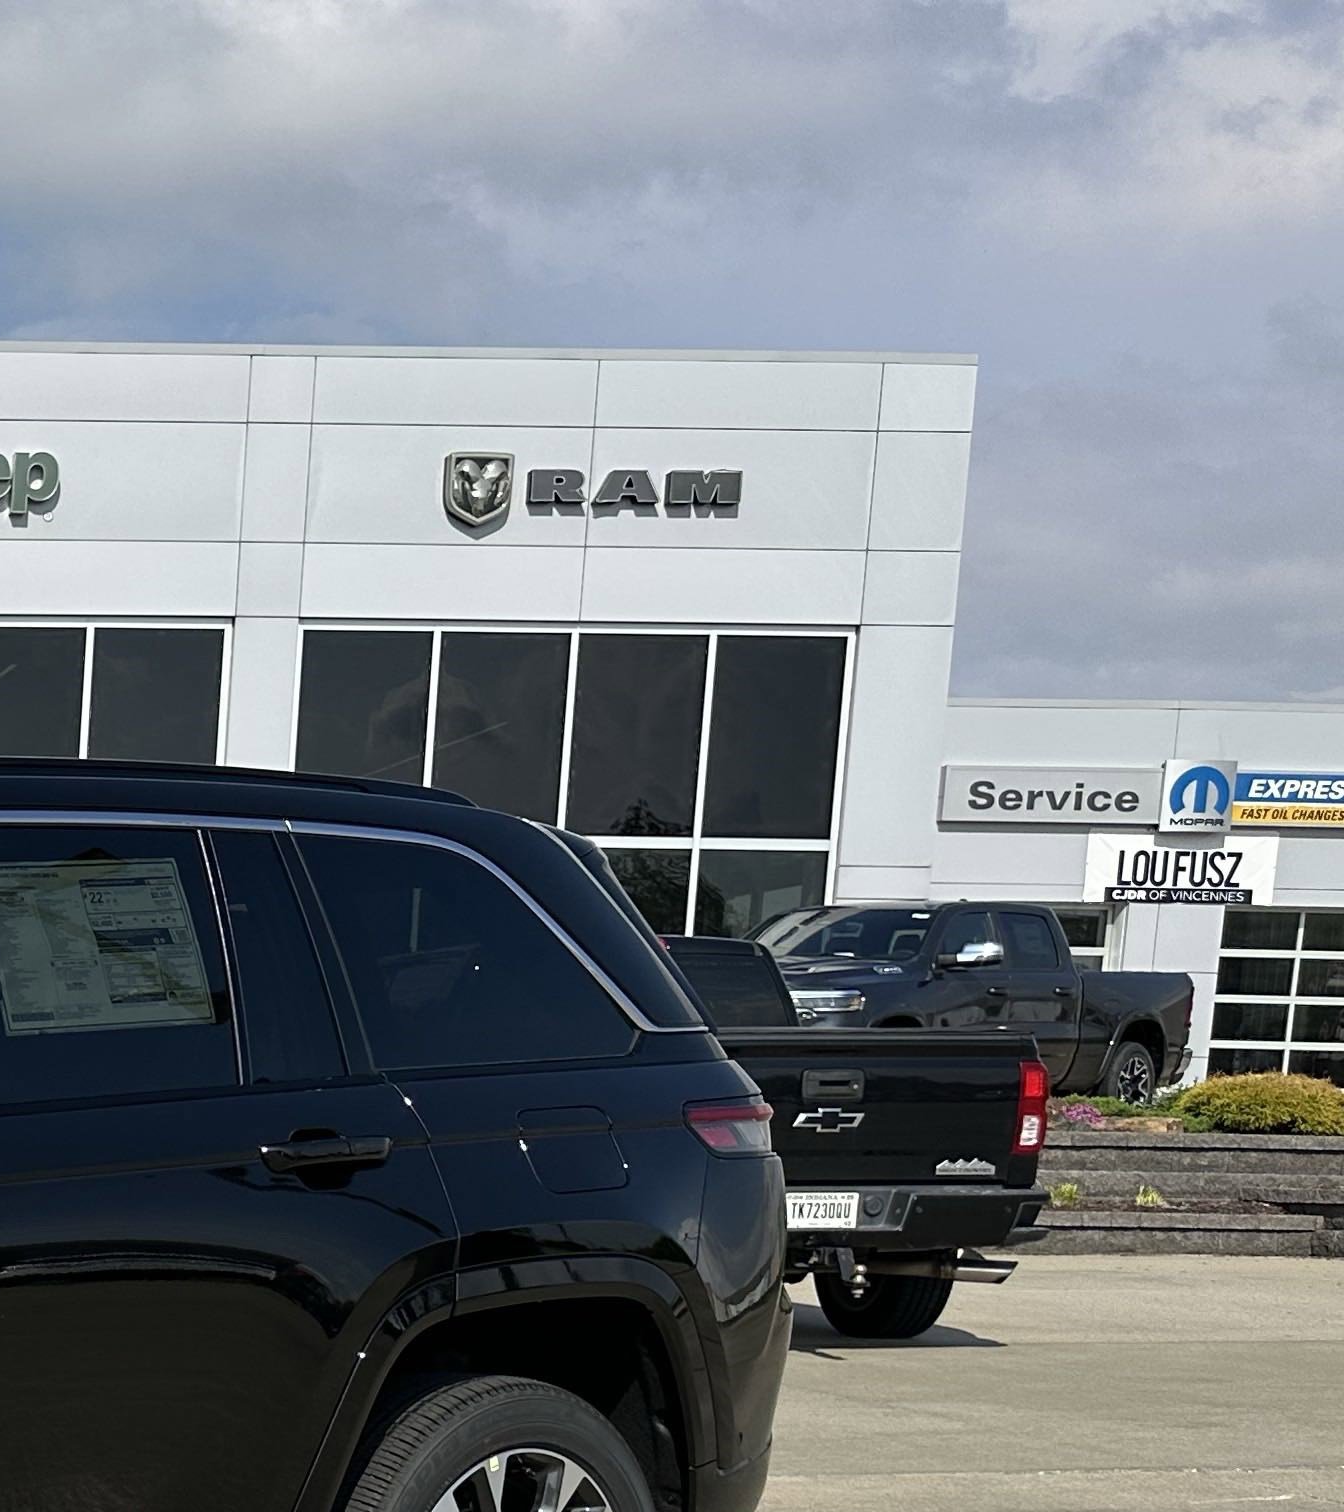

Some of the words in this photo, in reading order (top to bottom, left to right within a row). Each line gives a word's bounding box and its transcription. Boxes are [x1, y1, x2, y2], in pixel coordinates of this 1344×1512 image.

[525, 468, 743, 505] RAM
[968, 780, 1140, 813] Service
[1169, 817, 1225, 827] MOPAR
[1239, 808, 1268, 821] FAST
[1271, 809, 1289, 821] OIL
[1116, 850, 1170, 887] LOU
[1172, 851, 1243, 888] FUSZ
[1111, 889, 1147, 901] CJDR
[1148, 889, 1168, 901] OF
[1170, 890, 1245, 902] VINCENNES
